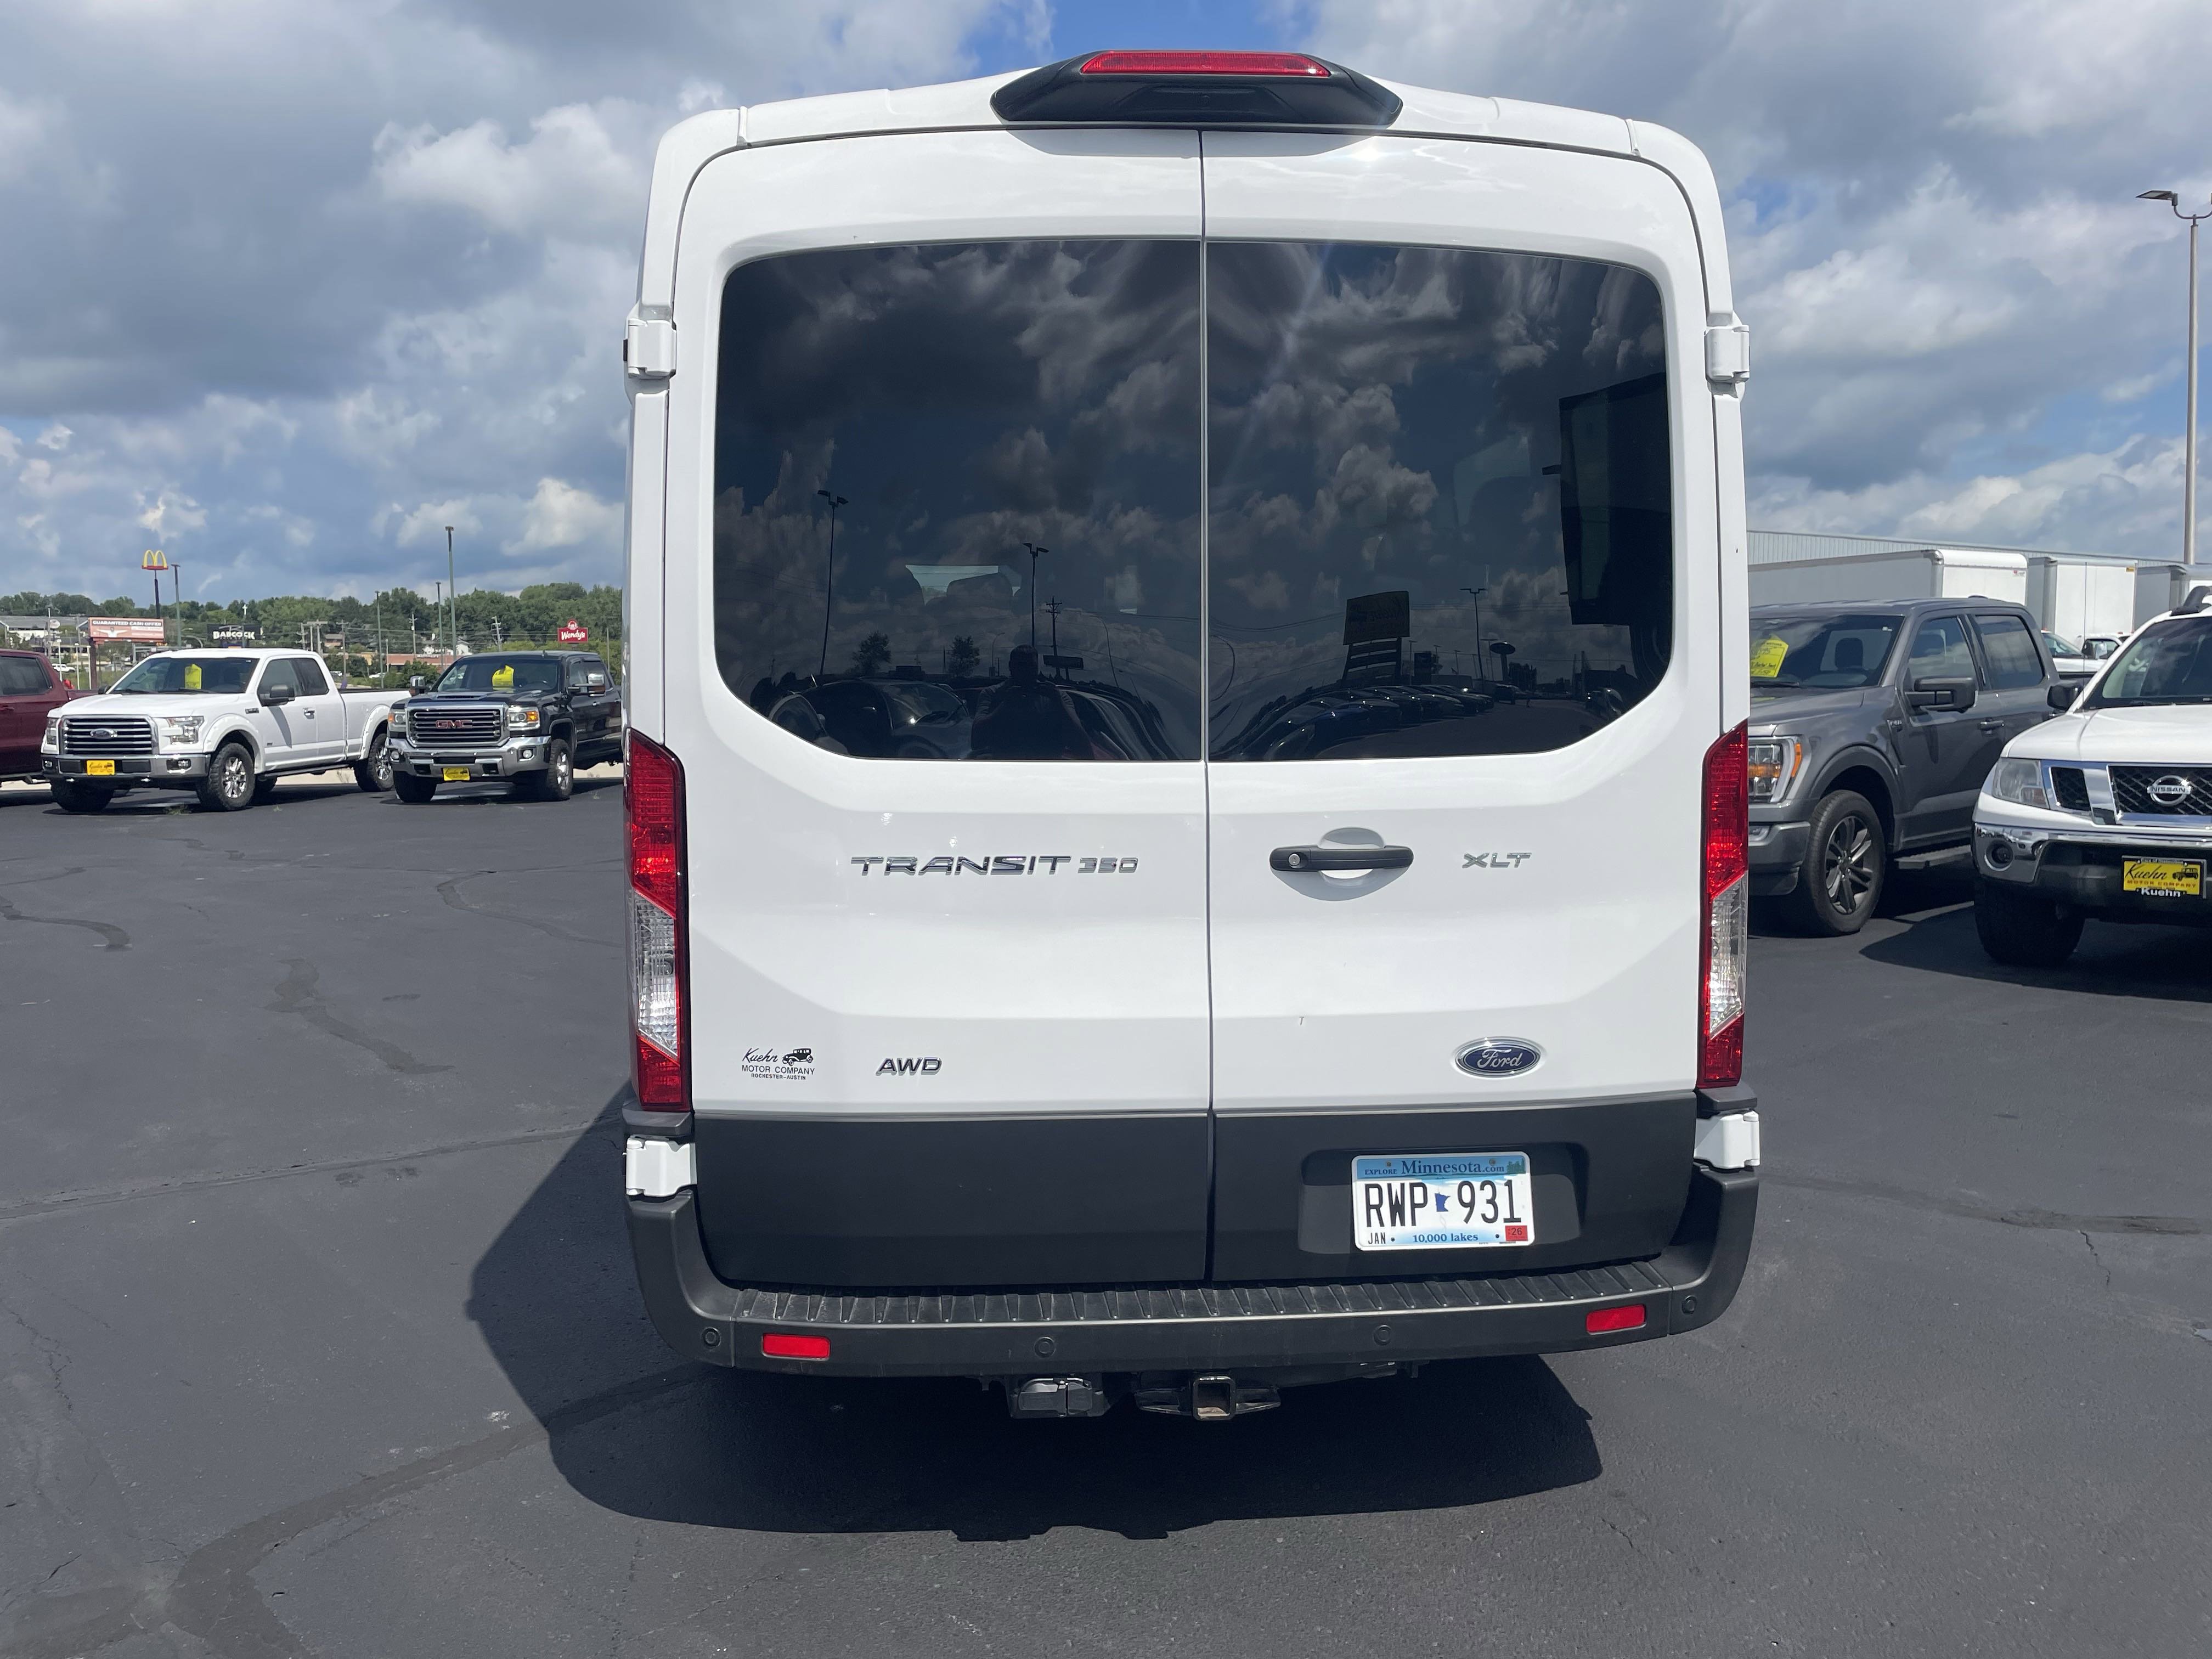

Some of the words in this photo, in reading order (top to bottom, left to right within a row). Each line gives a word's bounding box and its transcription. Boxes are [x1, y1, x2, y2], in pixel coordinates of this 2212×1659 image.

[561, 630, 585, 640] Wendy's
[436, 720, 472, 729] GMC
[851, 856, 1071, 876] TRANSIT
[1077, 857, 1138, 873] 350
[1462, 852, 1532, 868] XLT
[2125, 864, 2167, 879] Kuehn
[2141, 887, 2181, 898] Kuehn
[742, 1048, 778, 1063] Kuehn
[1477, 1048, 1523, 1068] Ford
[742, 1065, 771, 1073] MOTOR
[775, 1066, 815, 1075] COMPANY
[876, 1057, 942, 1076] AWD
[1364, 1182, 1429, 1228] RWP
[1457, 1179, 1521, 1224] 931
[1368, 1232, 1386, 1245] JAN
[1511, 1227, 1522, 1235] 26
